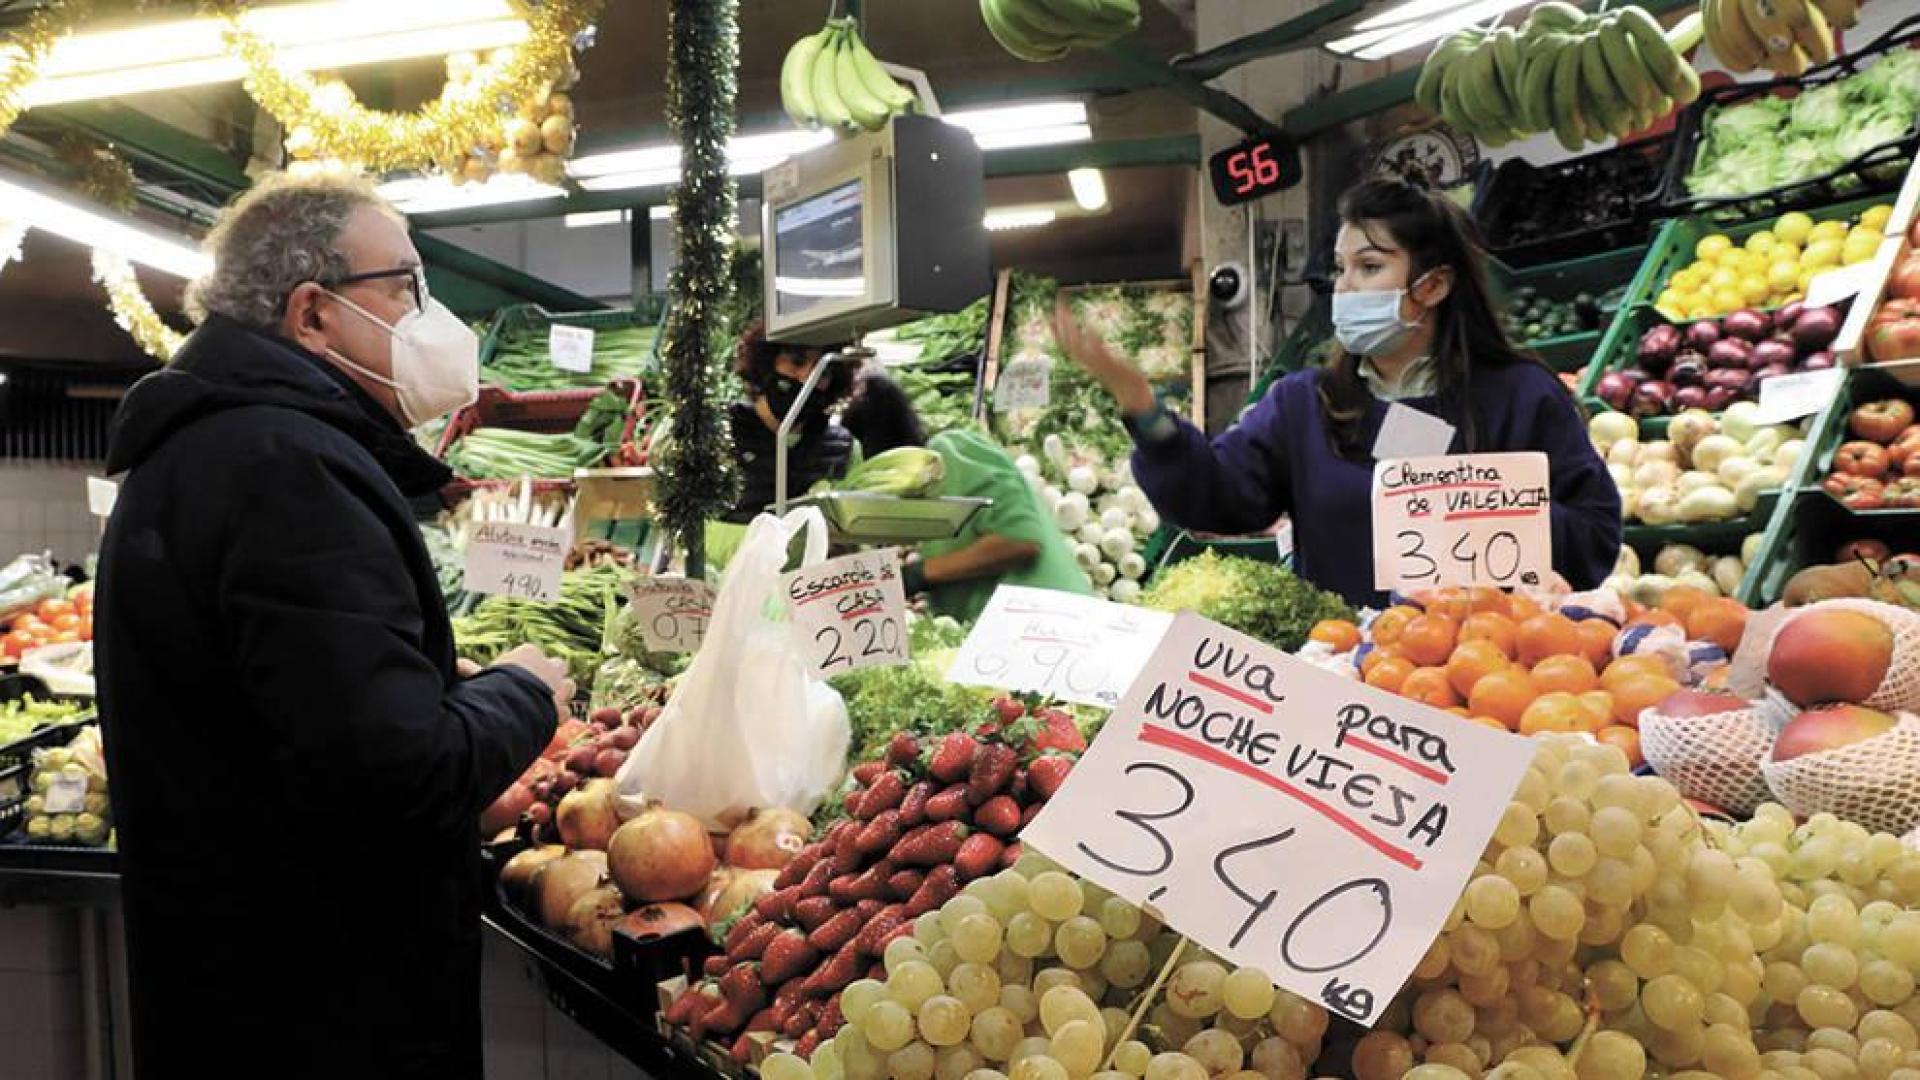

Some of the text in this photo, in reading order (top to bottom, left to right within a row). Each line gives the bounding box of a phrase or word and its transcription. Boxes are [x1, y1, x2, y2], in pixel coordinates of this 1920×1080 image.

[1227, 142, 1279, 194] 56
[1406, 486, 1550, 514] de VALENCIA
[1396, 530, 1521, 585] 3,40
[1143, 682, 1281, 765] NOCHE
[1334, 703, 1457, 774] para
[1077, 761, 1392, 972] 3,40
